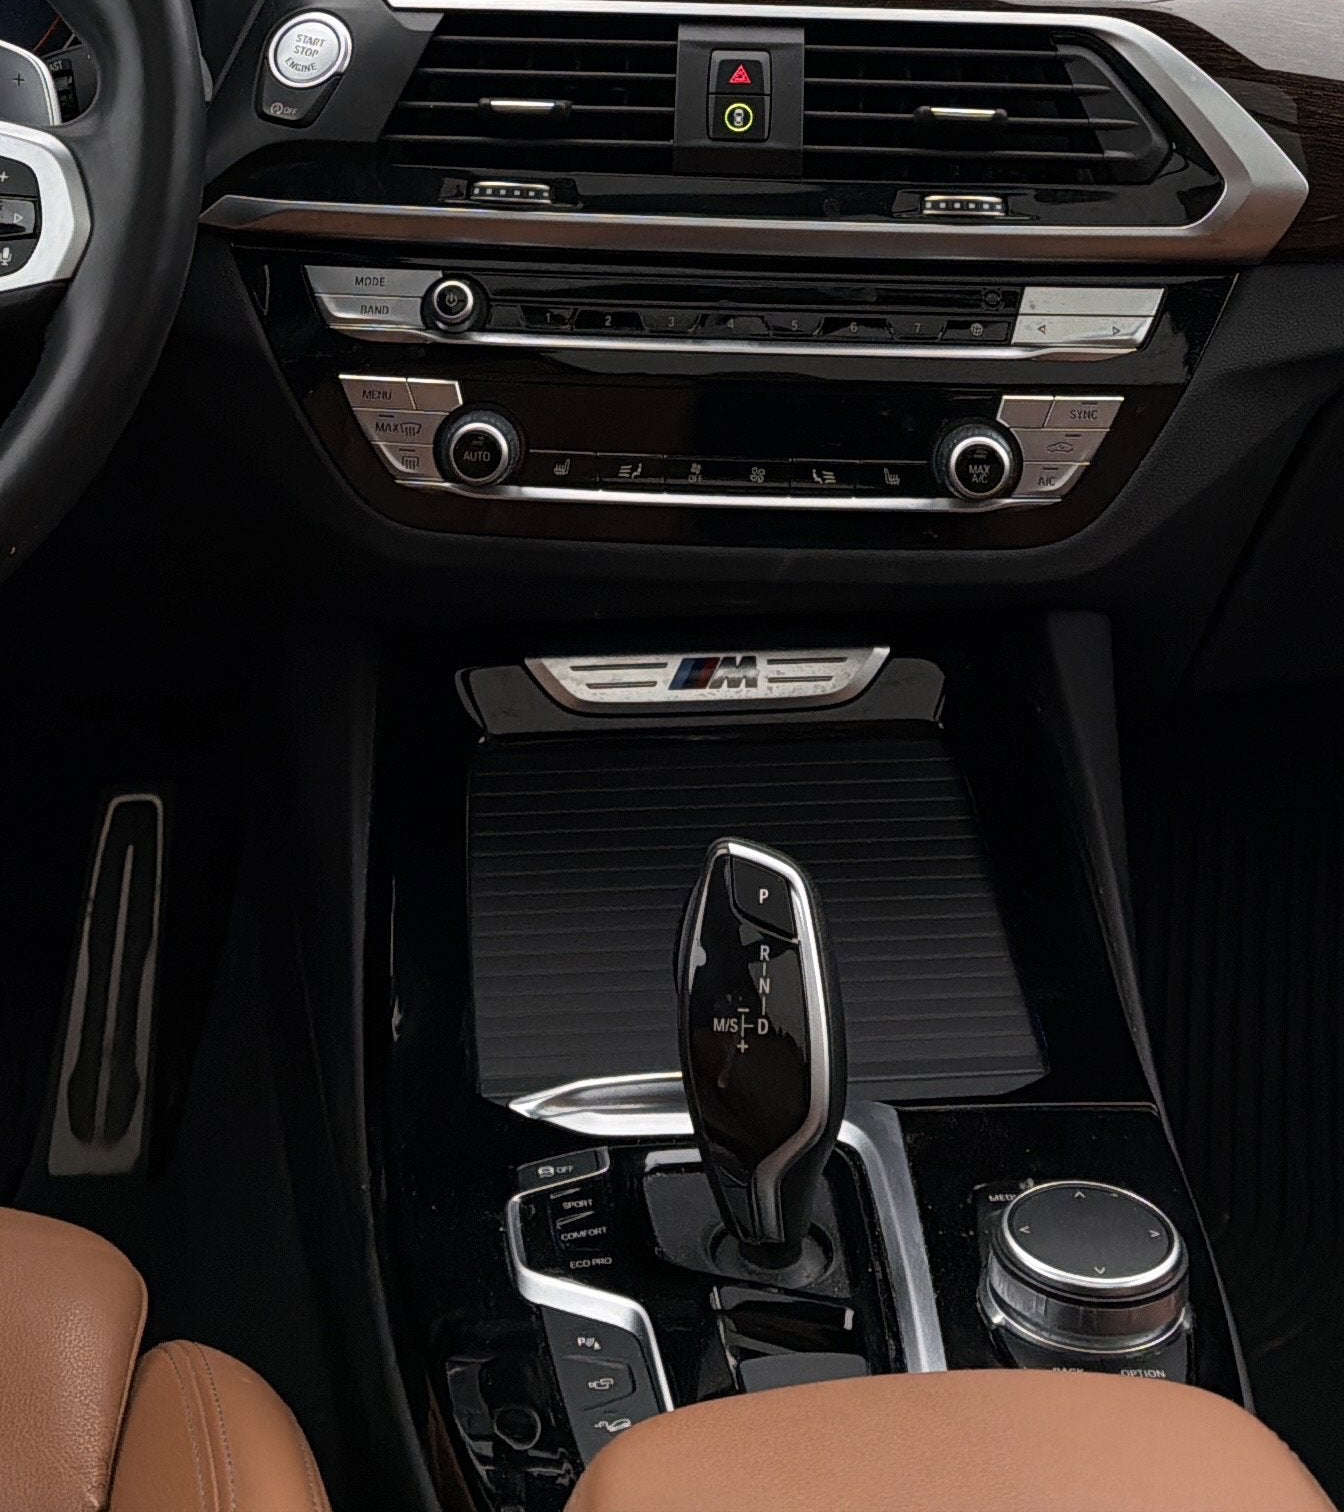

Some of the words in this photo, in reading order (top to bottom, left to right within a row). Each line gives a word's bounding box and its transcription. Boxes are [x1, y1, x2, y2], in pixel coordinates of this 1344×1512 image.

[295, 33, 327, 48] START
[293, 45, 320, 57] STOP
[284, 56, 318, 73] ENGINE
[283, 106, 298, 116] OFF
[355, 275, 386, 288] MODE
[360, 303, 390, 317] BAND
[545, 312, 551, 324] 1
[604, 314, 613, 328] 2
[668, 315, 676, 328] 3
[727, 318, 736, 331] 4
[790, 320, 798, 332] 5
[849, 321, 858, 334] 6
[914, 322, 922, 335] 7
[362, 389, 392, 402] MENU
[1069, 407, 1098, 421] SYNC
[375, 421, 399, 435] MAX
[462, 449, 491, 464] AUTO
[968, 464, 991, 476] MAX
[688, 474, 704, 484] OFF
[972, 473, 989, 485] A/C
[1038, 475, 1056, 487] A/C
[759, 888, 769, 904] P
[759, 945, 770, 961] R
[758, 977, 770, 994] N
[713, 1018, 738, 1033] M/S
[757, 1019, 769, 1035] D
[556, 1164, 574, 1175] OFF
[562, 1198, 593, 1211] SPORT
[560, 1226, 608, 1242] COMFORT
[569, 1259, 591, 1270] ECO
[591, 1256, 612, 1268] PRO
[1120, 1368, 1166, 1378] OPTION
